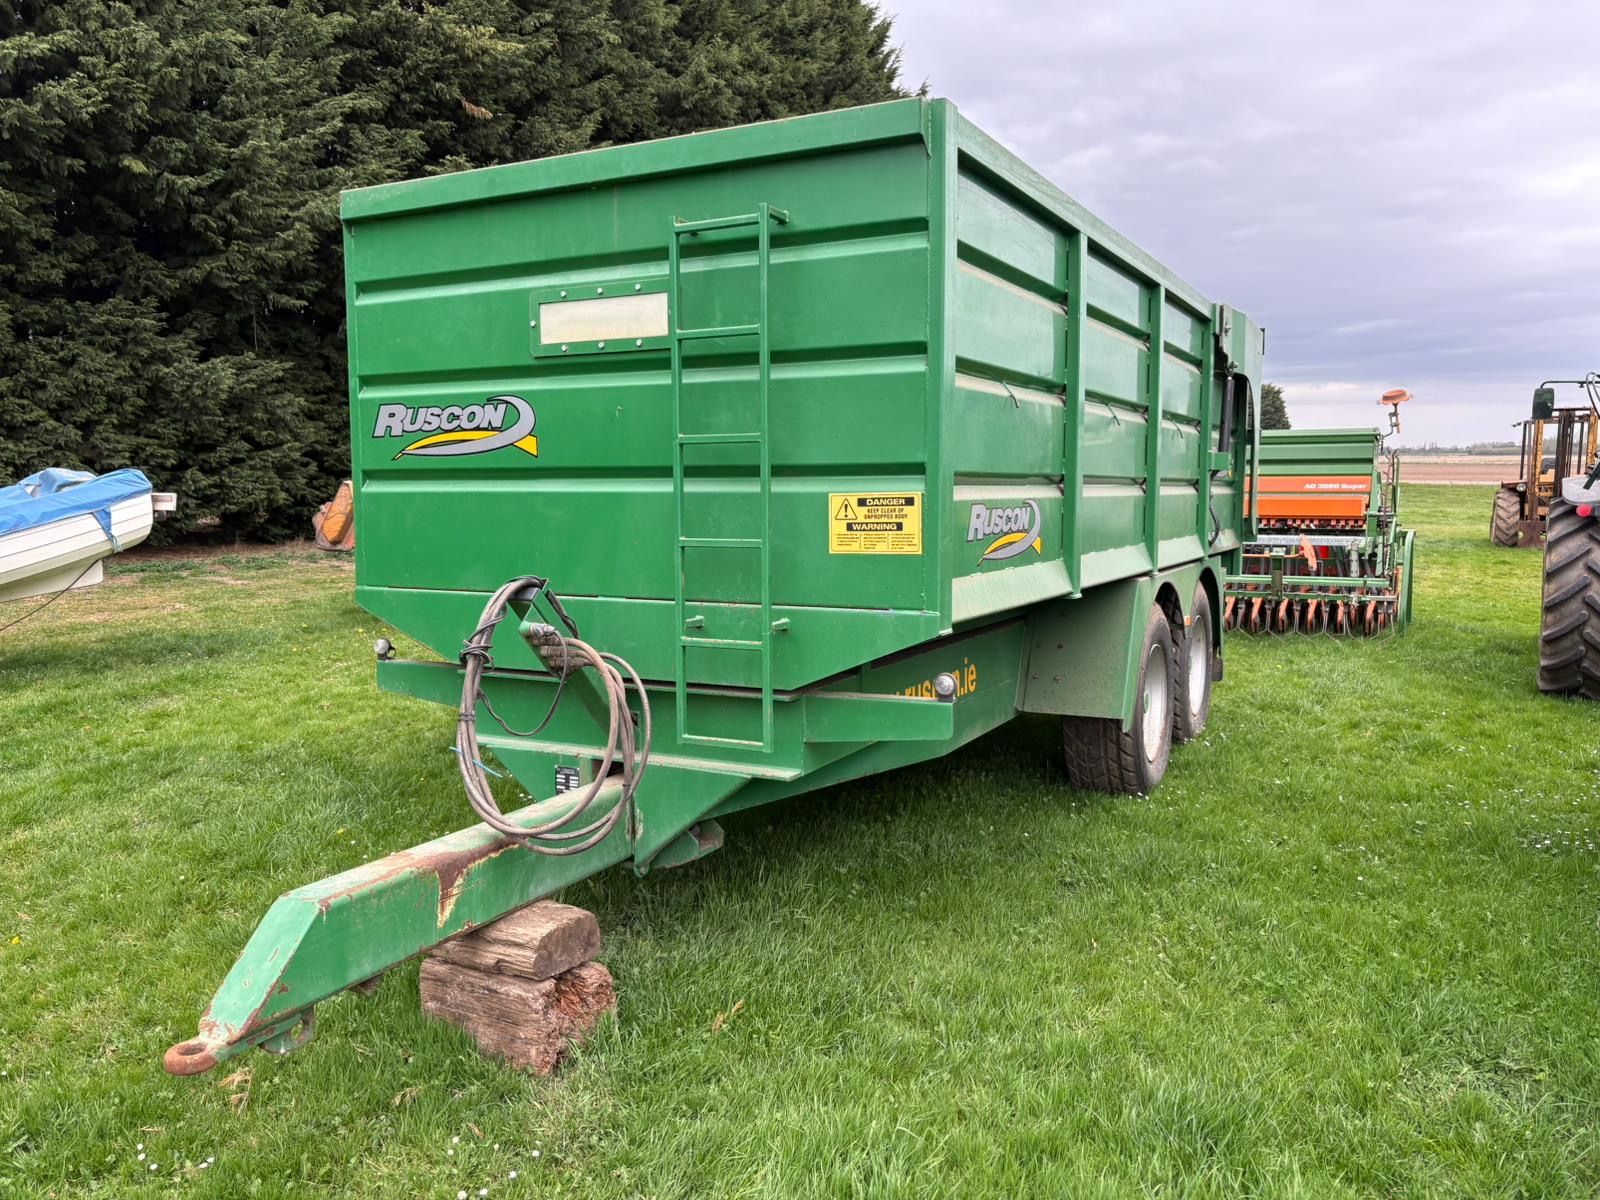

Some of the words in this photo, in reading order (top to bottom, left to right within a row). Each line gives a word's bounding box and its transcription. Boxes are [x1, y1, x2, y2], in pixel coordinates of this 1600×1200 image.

[372, 402, 509, 439] RUSCON
[866, 498, 906, 506] DANGER
[966, 503, 1031, 543] RUSCON
